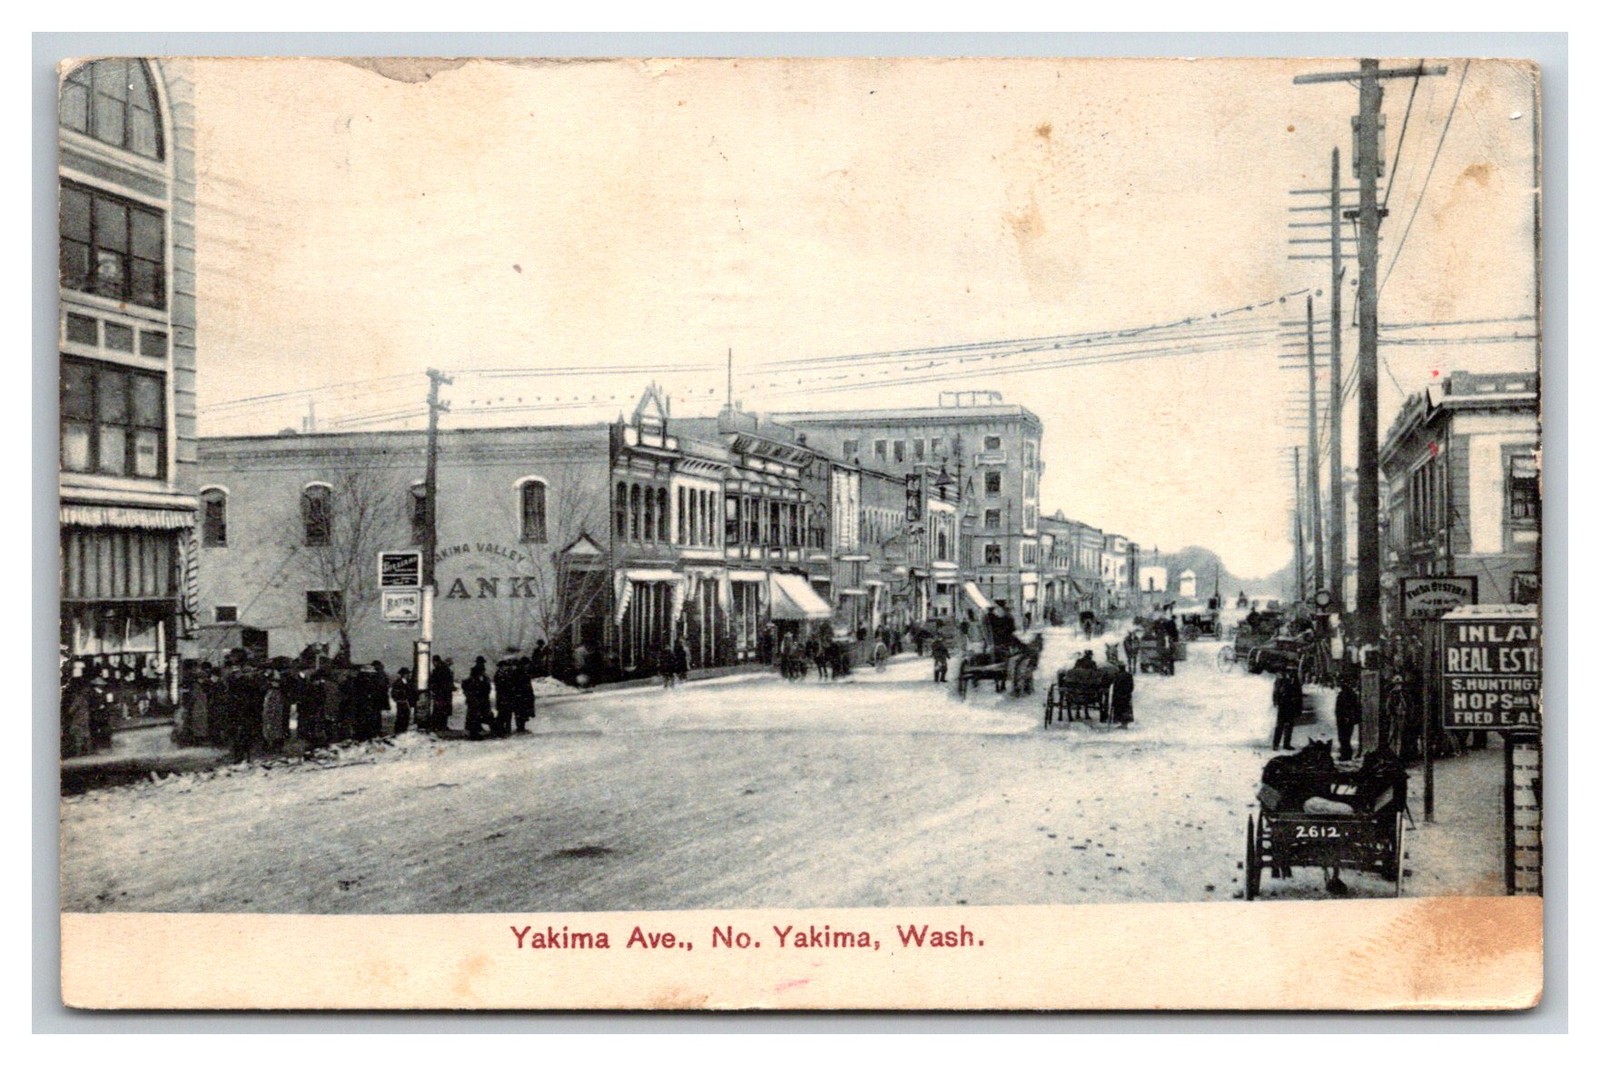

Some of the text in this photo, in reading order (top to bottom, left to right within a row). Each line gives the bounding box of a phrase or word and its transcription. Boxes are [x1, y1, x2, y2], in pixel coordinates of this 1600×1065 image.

[434, 543, 526, 563] AKIMA VALLEY
[1447, 647, 1492, 672] REAL
[1453, 692, 1513, 709] HOPS
[1454, 712, 1493, 724] FRED
[1500, 712, 1513, 724] E.
